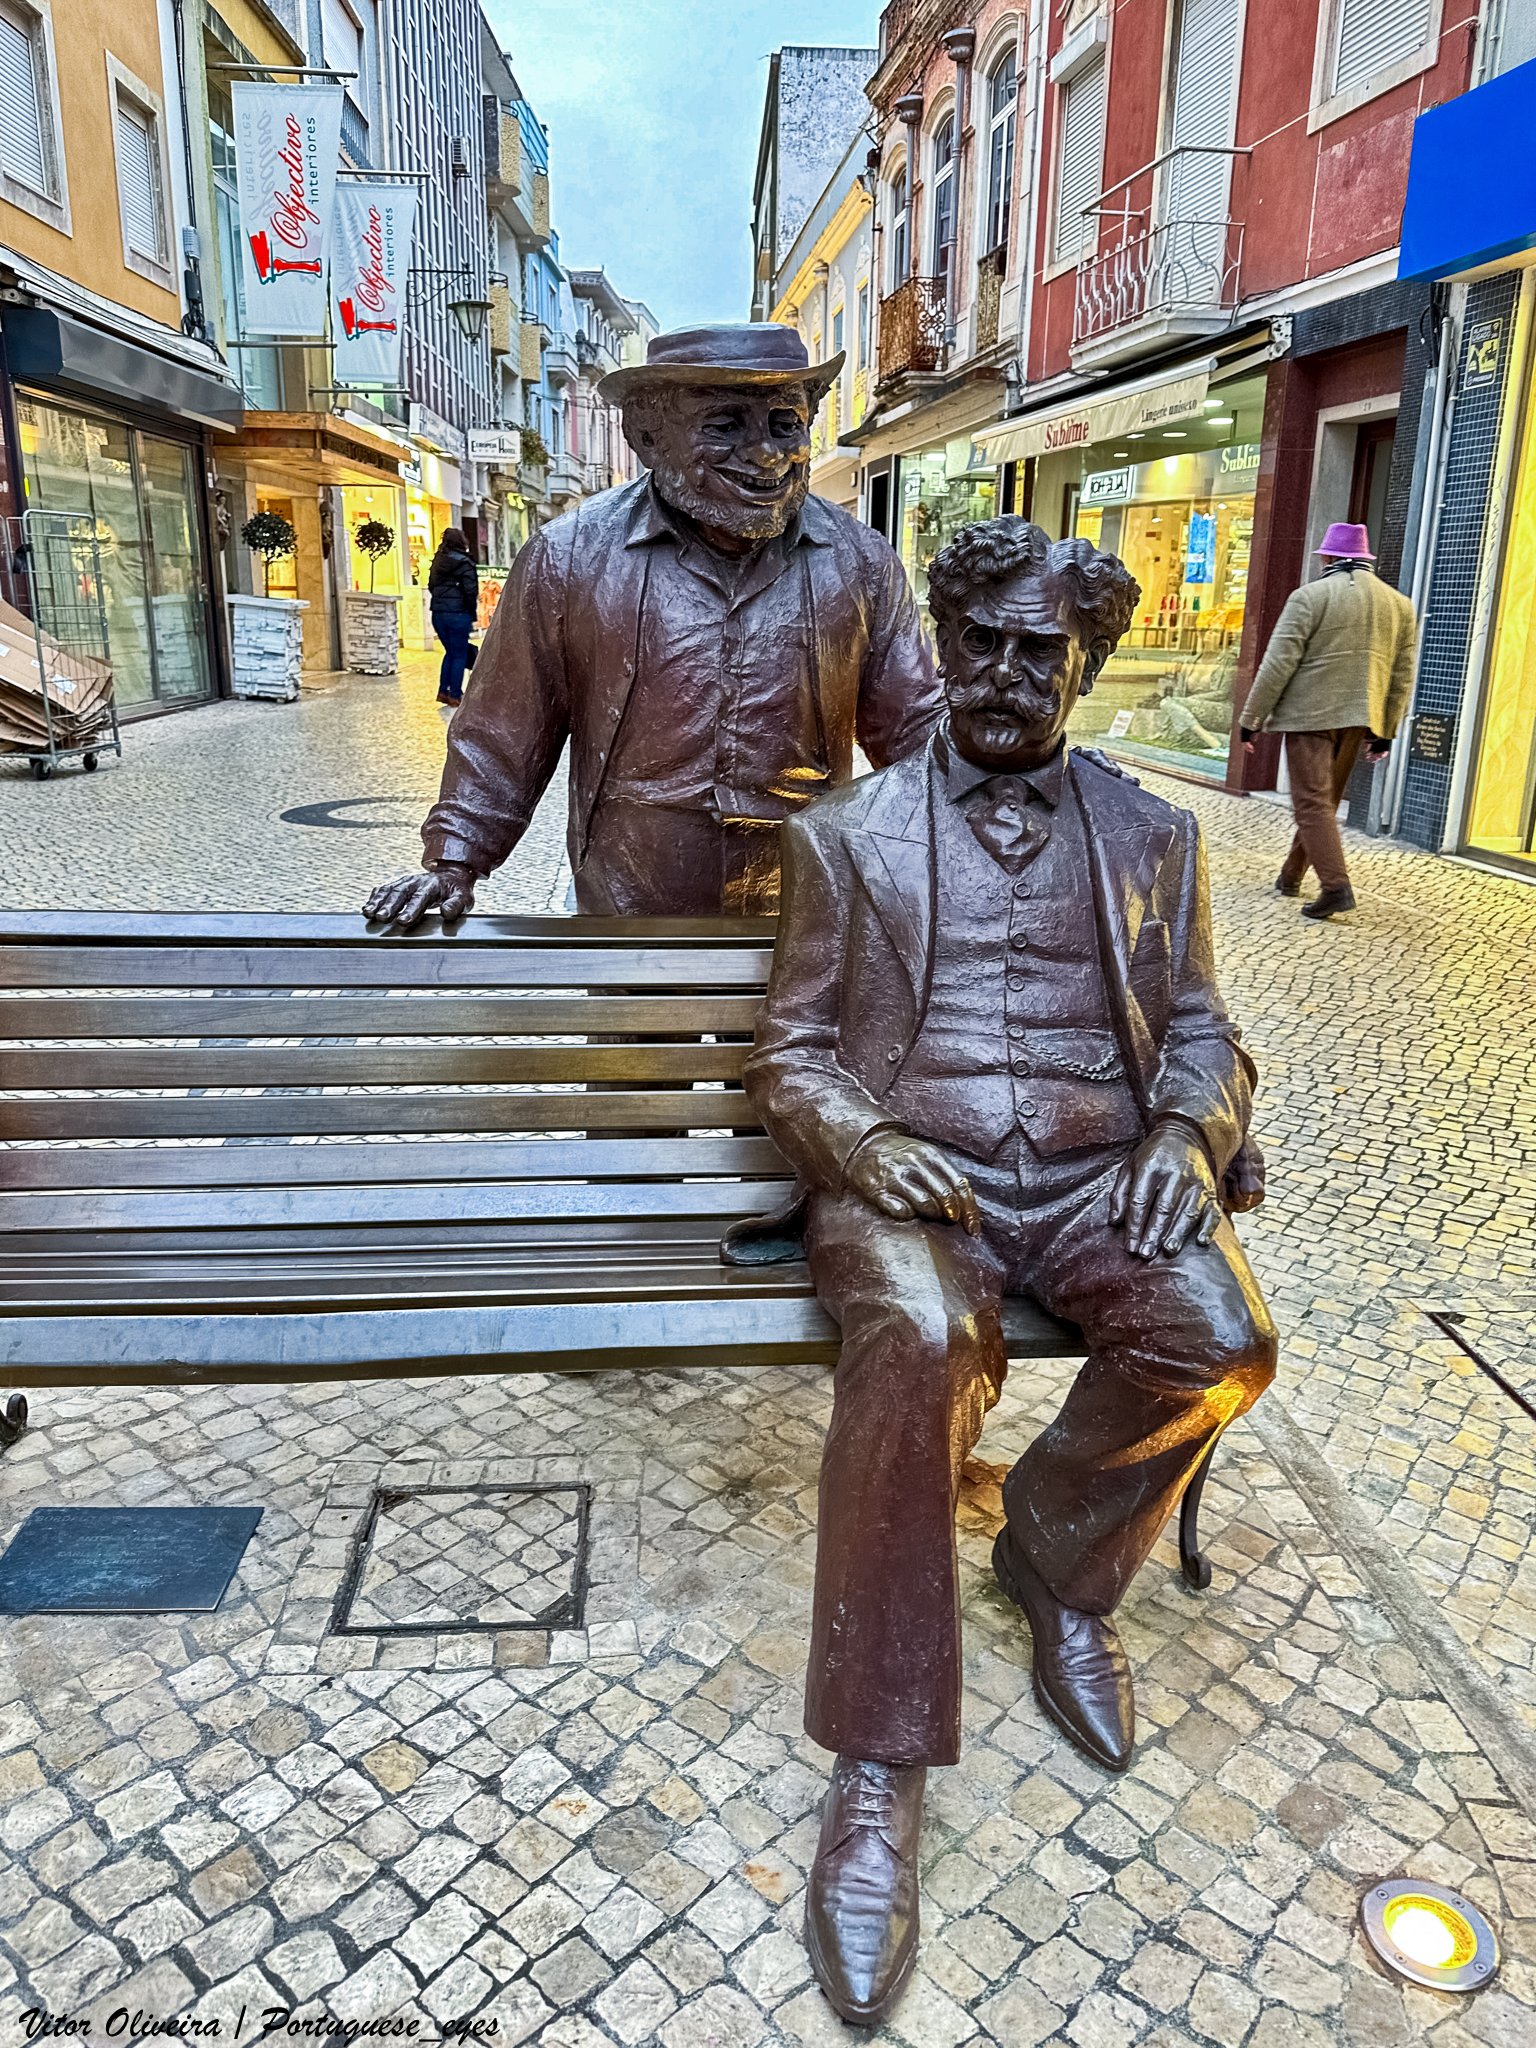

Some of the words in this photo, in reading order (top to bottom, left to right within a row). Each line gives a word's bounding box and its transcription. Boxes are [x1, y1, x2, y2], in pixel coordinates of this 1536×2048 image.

[270, 112, 320, 249] Objectivo
[306, 117, 319, 205] interiores
[355, 204, 396, 312] Objectivo
[384, 207, 395, 277] interiores
[1045, 418, 1089, 449] Sublime
